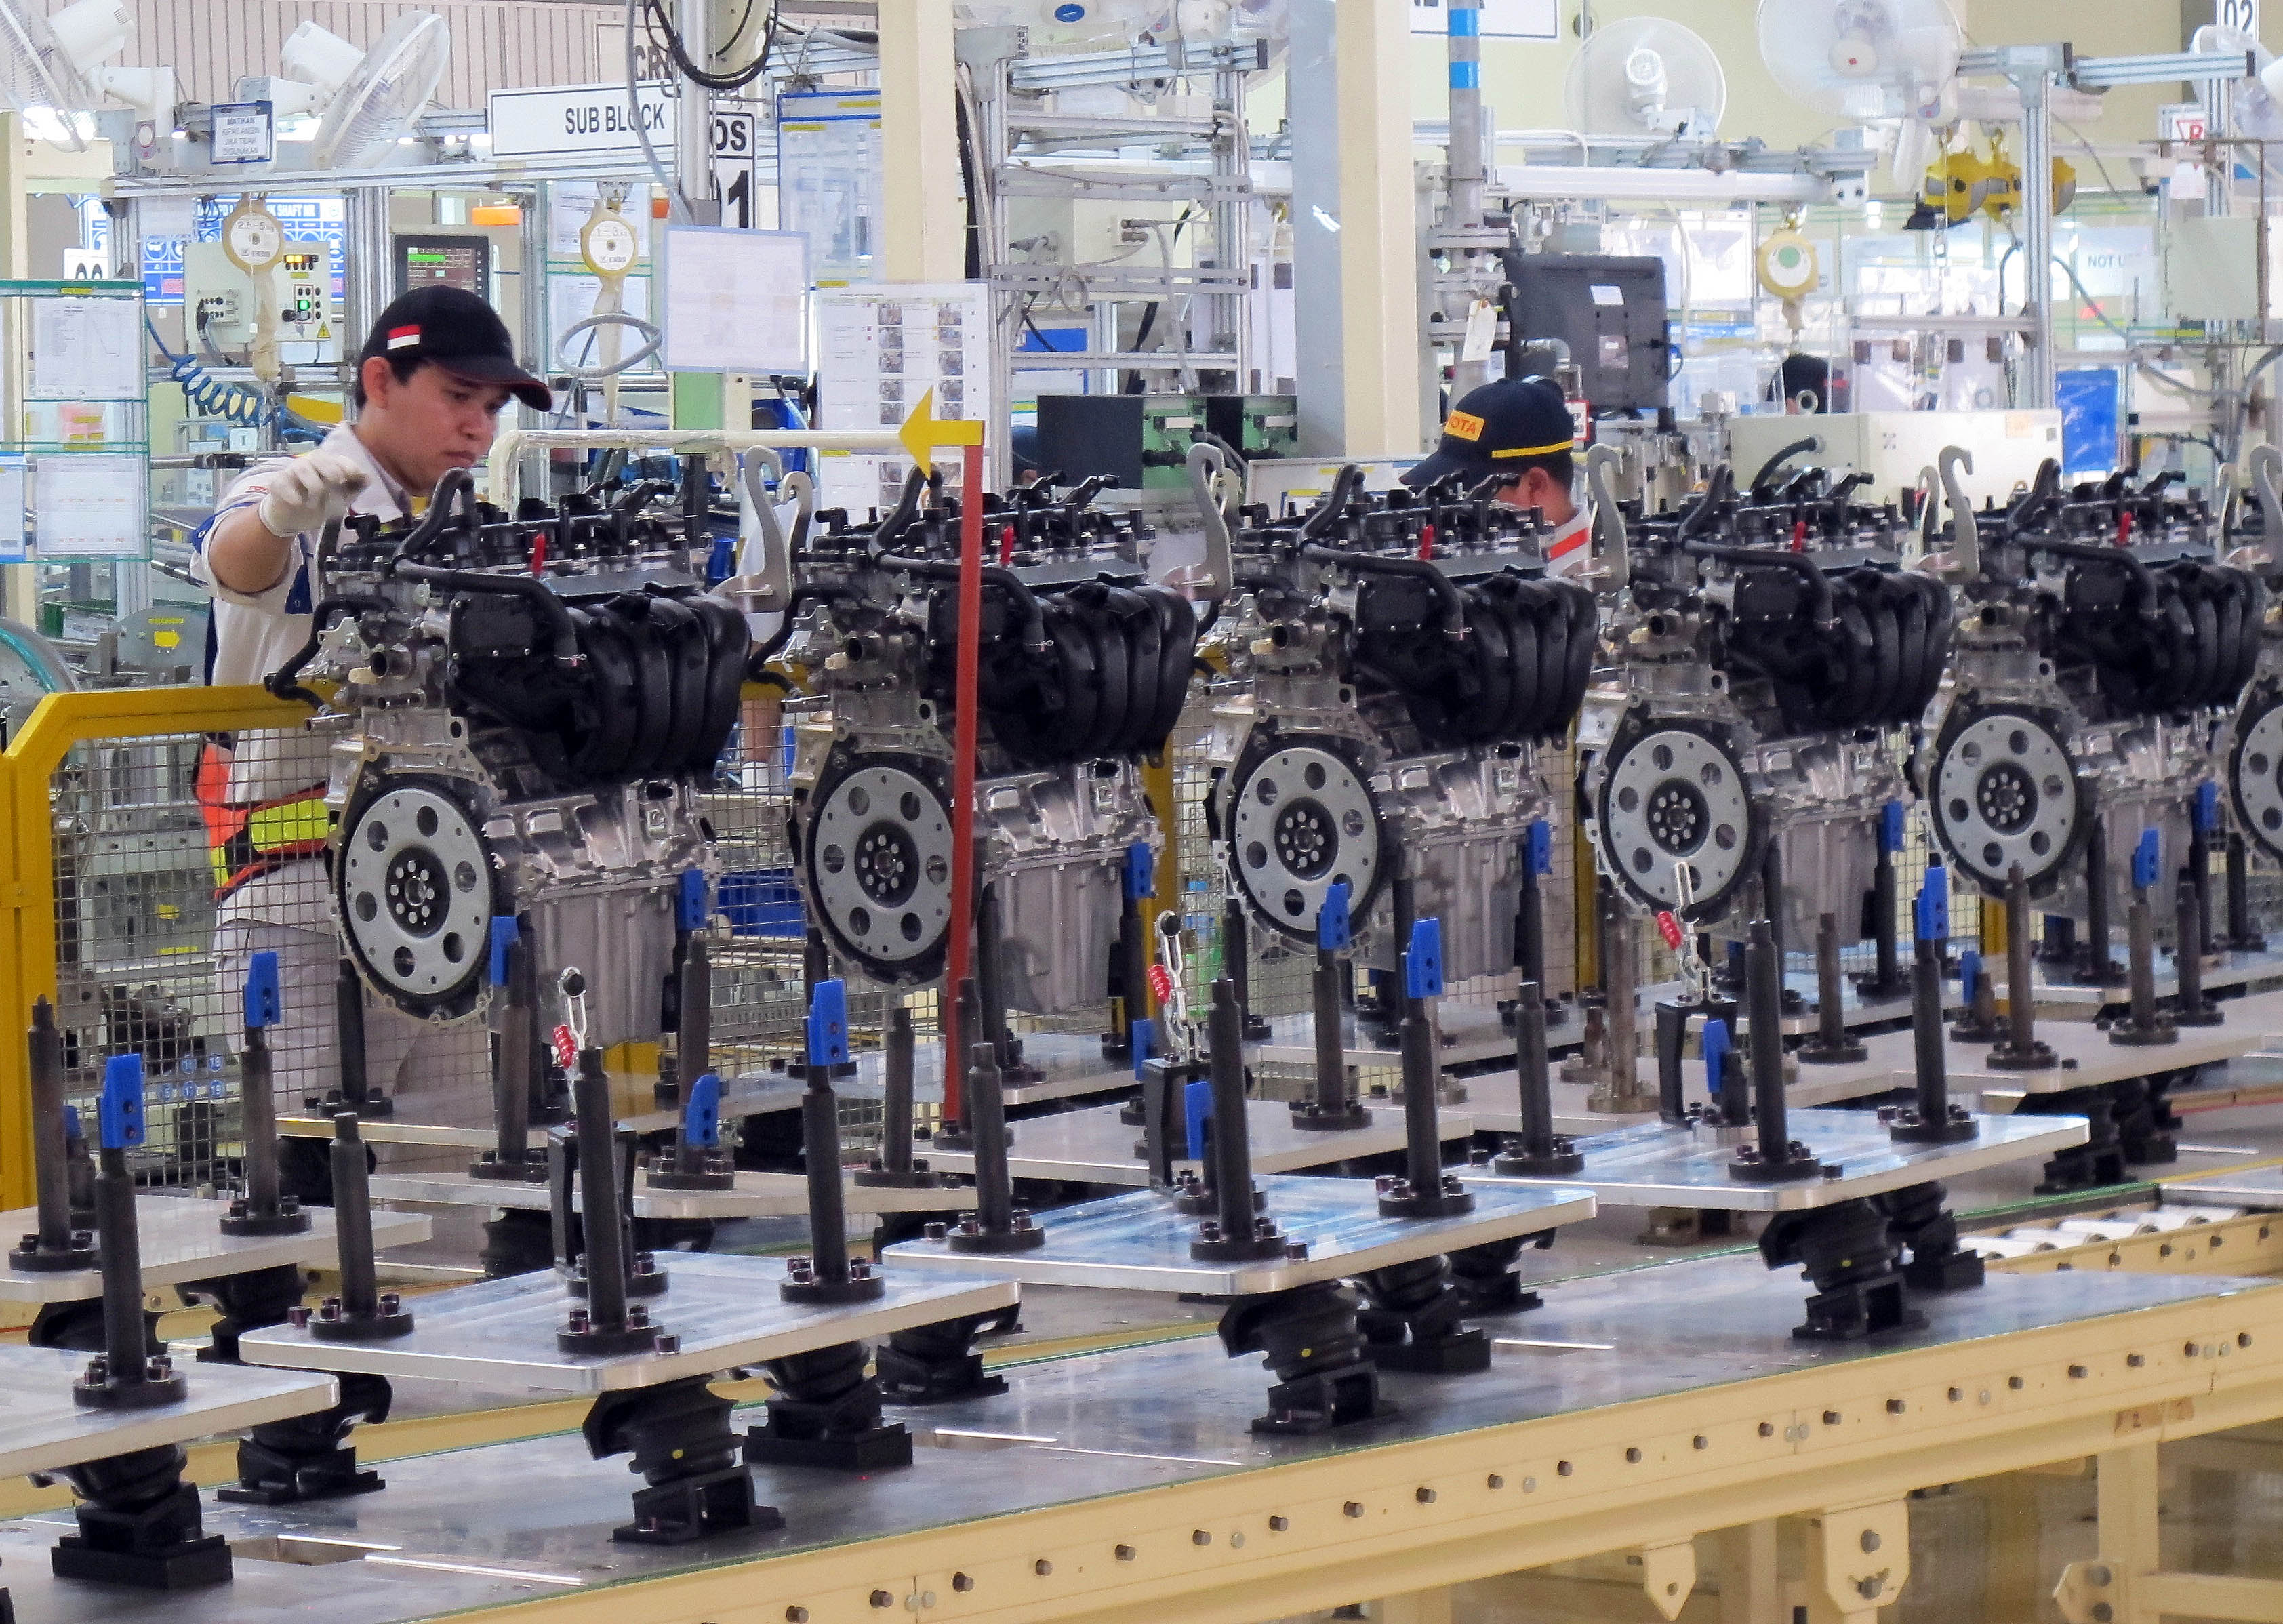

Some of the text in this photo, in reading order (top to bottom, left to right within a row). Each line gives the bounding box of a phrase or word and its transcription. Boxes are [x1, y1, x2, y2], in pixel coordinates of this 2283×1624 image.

[565, 107, 600, 134] SUB
[710, 119, 747, 151] OS
[1449, 415, 1476, 434] OTA
